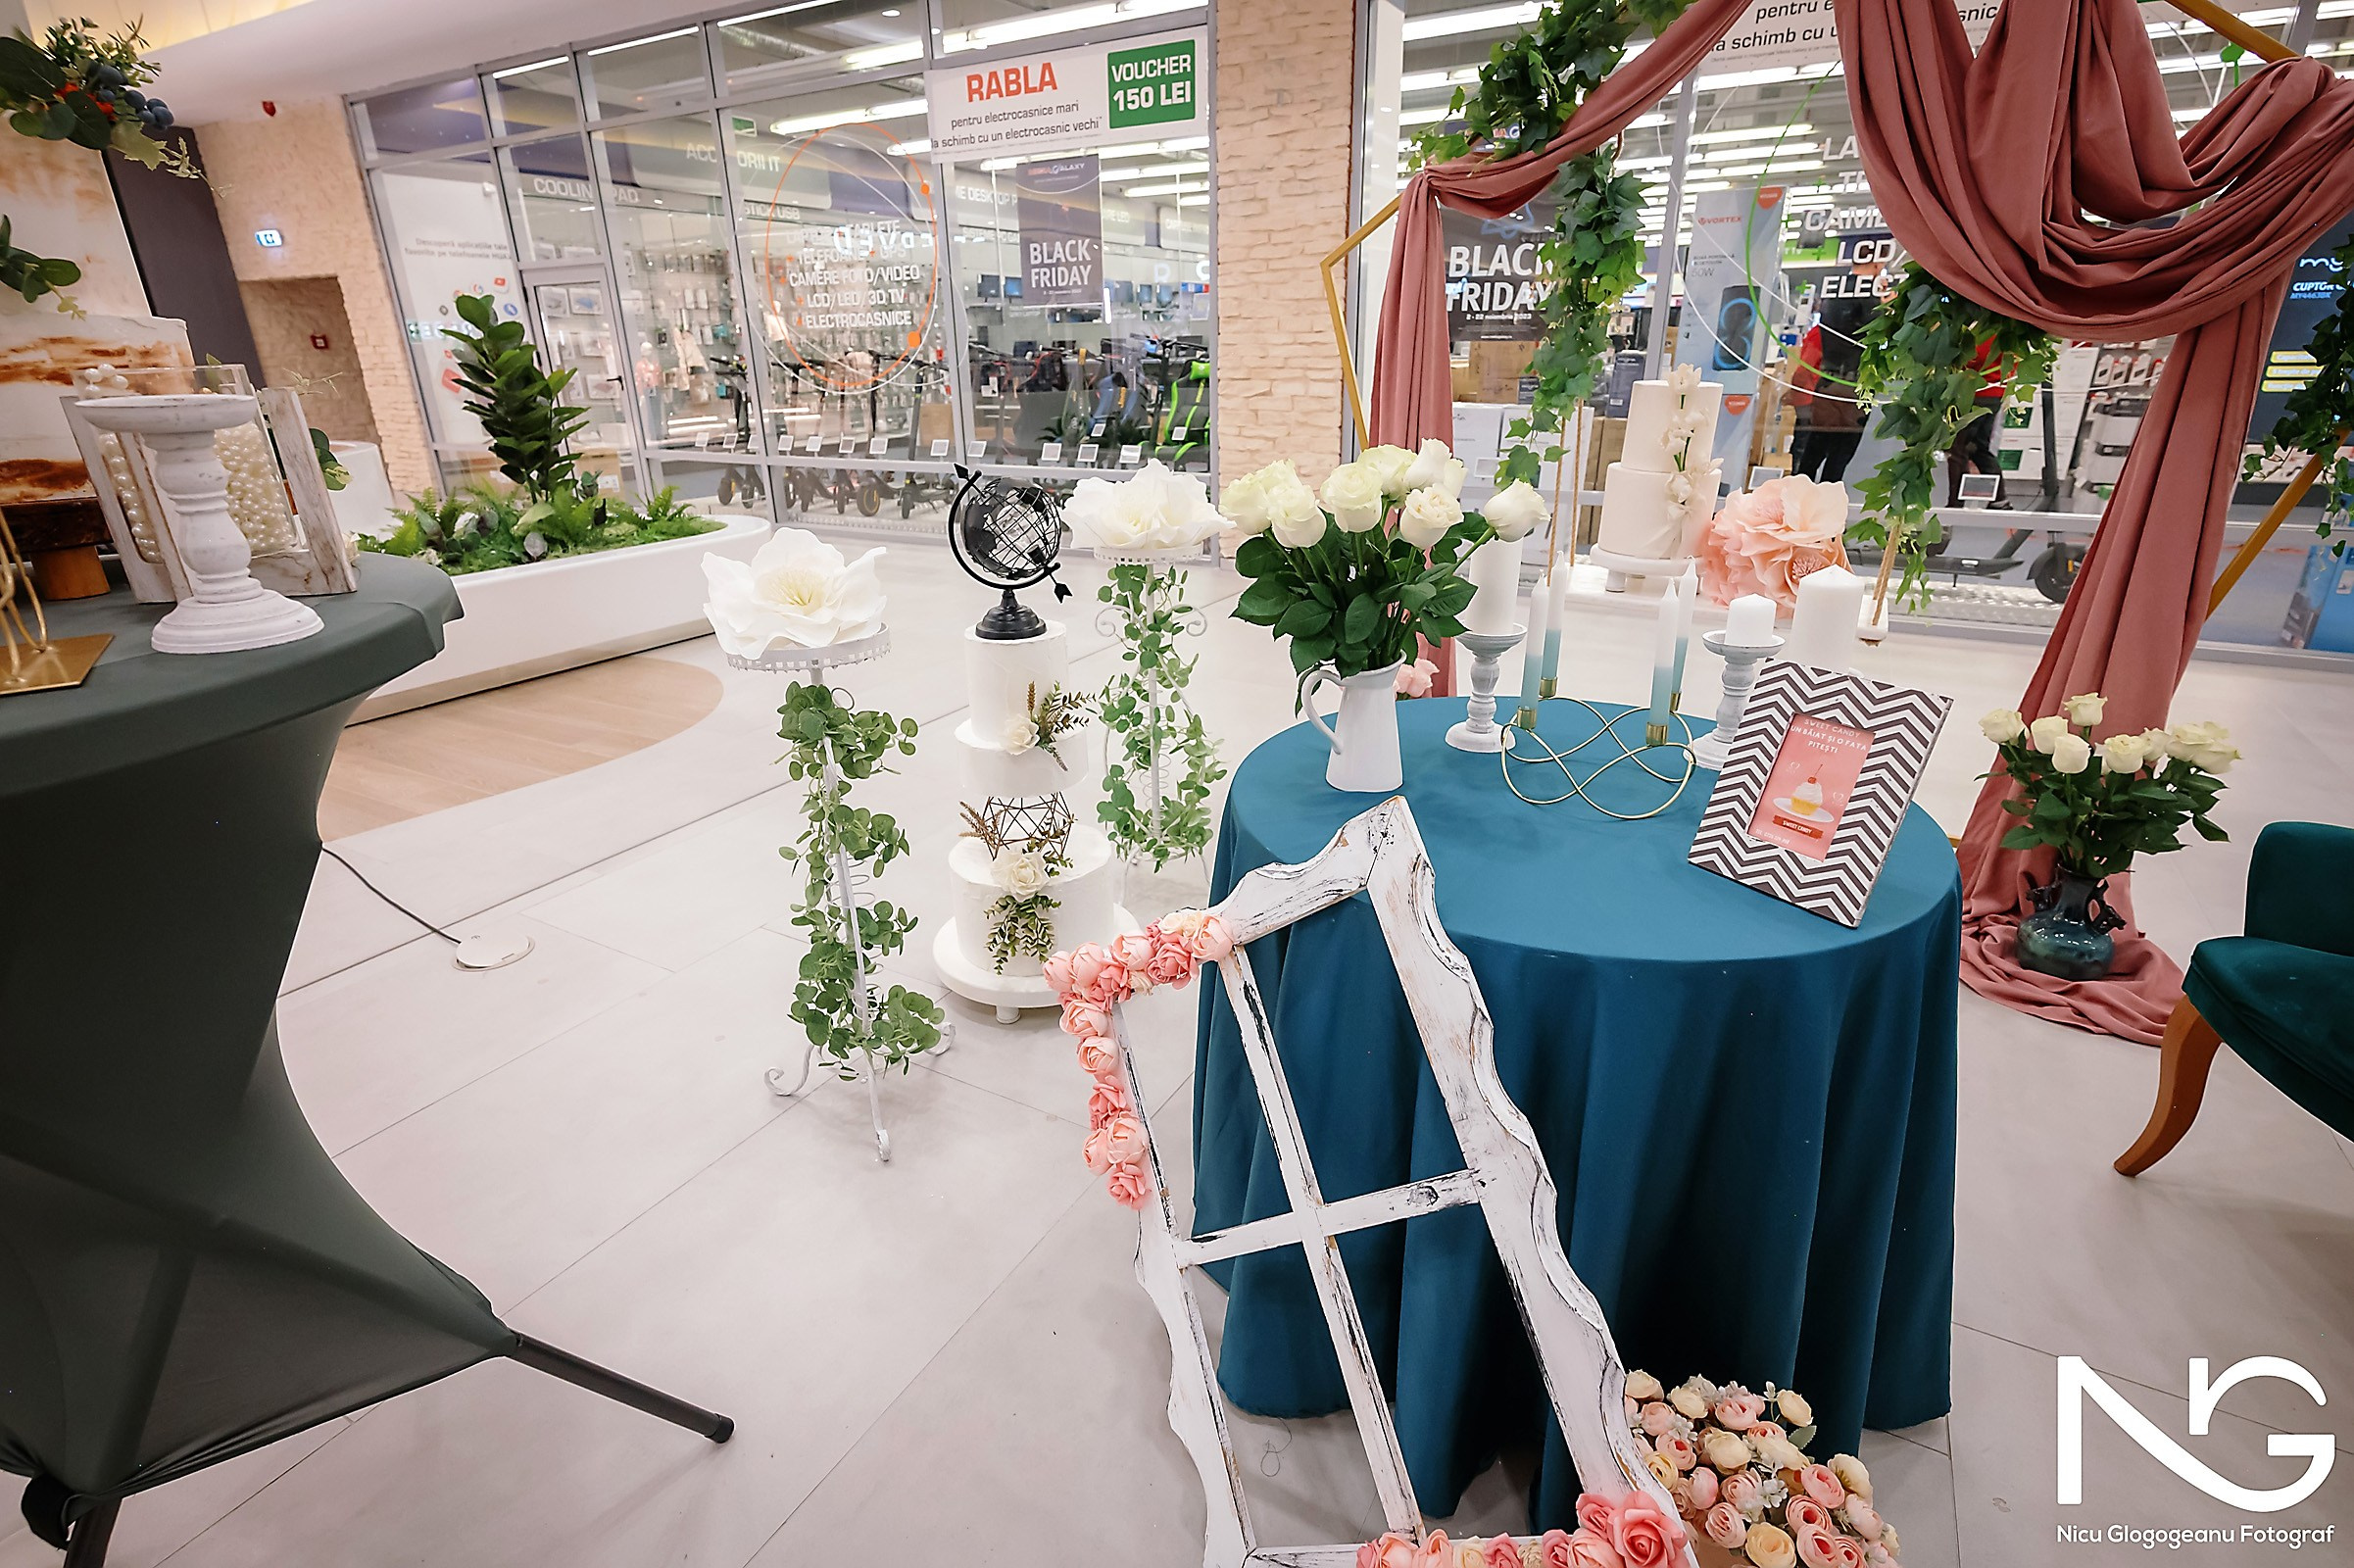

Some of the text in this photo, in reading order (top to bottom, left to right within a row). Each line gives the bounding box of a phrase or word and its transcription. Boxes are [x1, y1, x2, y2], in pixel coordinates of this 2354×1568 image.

[1755, 1, 1817, 24] pentru
[1732, 27, 1796, 49] schimb
[1802, 26, 1824, 41] cu
[1111, 54, 1191, 82] VOUCHER
[965, 62, 1057, 103] RABLA
[1113, 80, 1191, 112] 150 LEI
[951, 100, 1079, 130] pentru electrocasnice mari
[942, 133, 976, 148] schimb
[978, 134, 989, 144] cu
[991, 132, 1003, 142] un
[1005, 122, 1070, 140] electrocasnic
[1823, 135, 1860, 161] LA
[768, 156, 780, 172] IT
[533, 178, 594, 198] COOLIN
[777, 207, 800, 220] USB
[1029, 238, 1092, 265] BLACK
[789, 265, 920, 287] CAMERE FOTO/VIDEO
[1031, 265, 1092, 288] FRIDAY
[889, 289, 906, 304] TV
[806, 311, 912, 329] ELECTROCASNICE
[1804, 718, 1861, 738] SWEET CANDY
